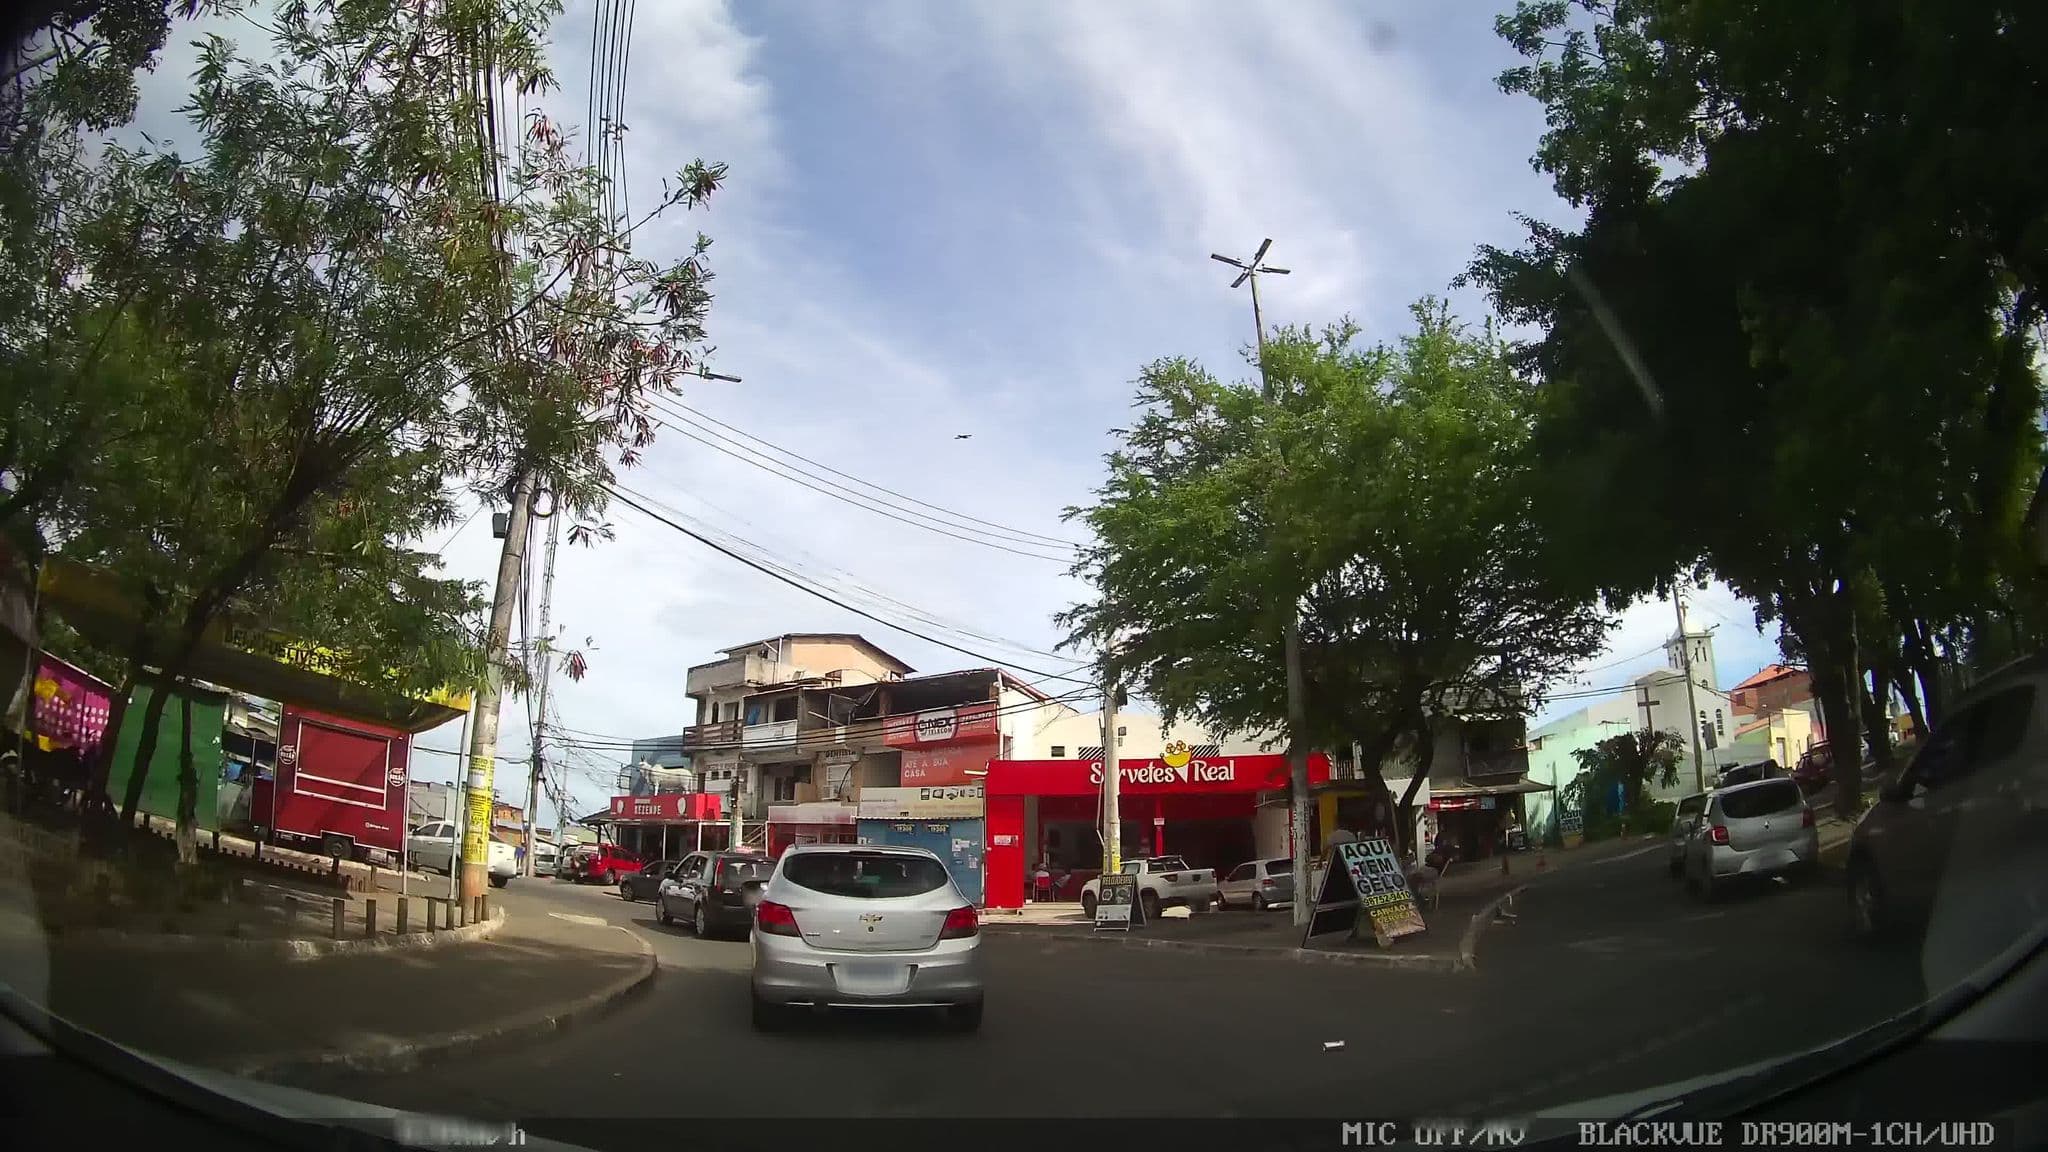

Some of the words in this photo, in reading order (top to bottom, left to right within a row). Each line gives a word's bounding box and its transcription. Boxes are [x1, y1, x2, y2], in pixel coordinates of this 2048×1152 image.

[904, 769, 926, 779] CASA
[1090, 761, 1176, 784] Srvetes
[1190, 759, 1236, 782] Real
[1345, 839, 1392, 860] AQUI
[1353, 857, 1394, 876] TEM
[1357, 872, 1406, 896] GELO
